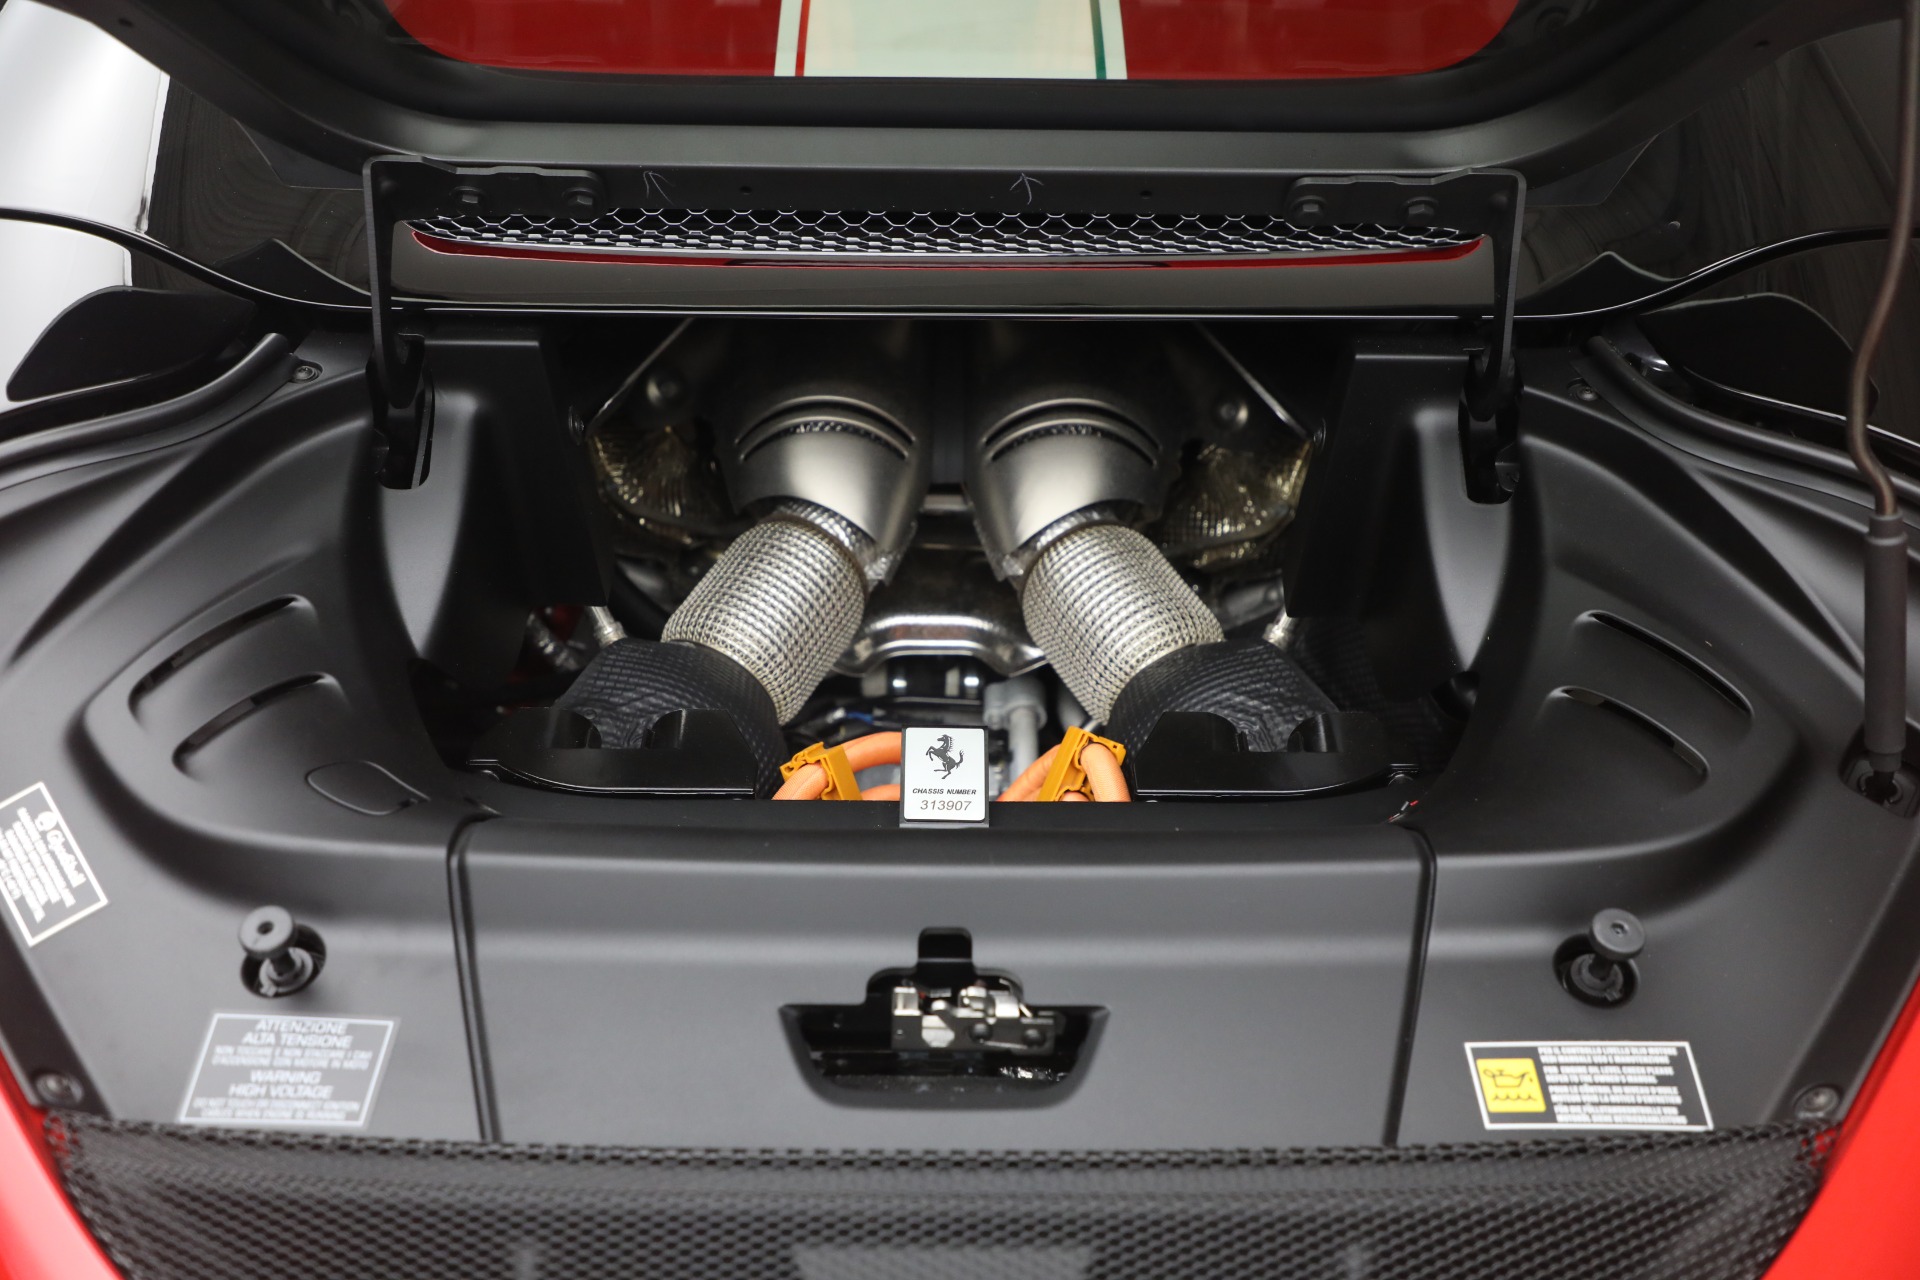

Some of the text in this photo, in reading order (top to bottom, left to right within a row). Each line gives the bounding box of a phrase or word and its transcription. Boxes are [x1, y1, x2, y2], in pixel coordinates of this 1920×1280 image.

[912, 787, 977, 796] CHASSIS NUMBER
[919, 799, 973, 811] 313907
[255, 1018, 348, 1035] ATTENZIONE
[242, 1031, 353, 1049] ALTA TENSIONE
[250, 1069, 322, 1085] WARNING
[228, 1083, 334, 1099] HIGH VOLTAGE
